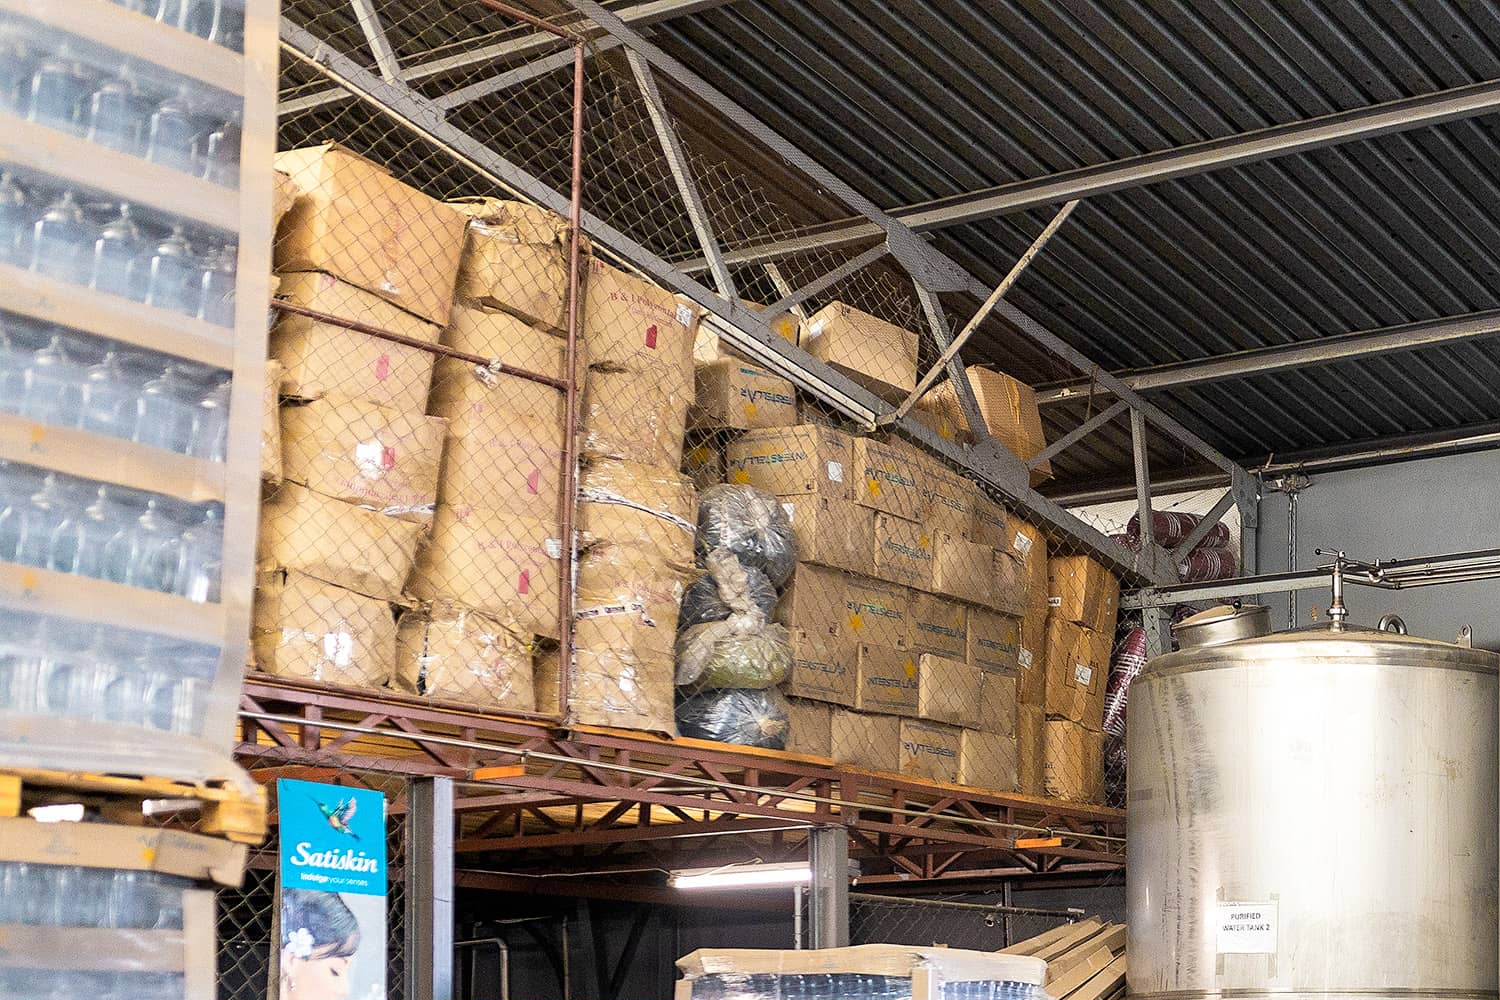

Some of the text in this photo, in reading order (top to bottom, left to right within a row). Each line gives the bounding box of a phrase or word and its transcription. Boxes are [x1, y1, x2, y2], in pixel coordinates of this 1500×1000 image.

[290, 842, 378, 873] Satiskin
[1230, 912, 1261, 920] PURIFIED
[1265, 923, 1270, 931] 2
